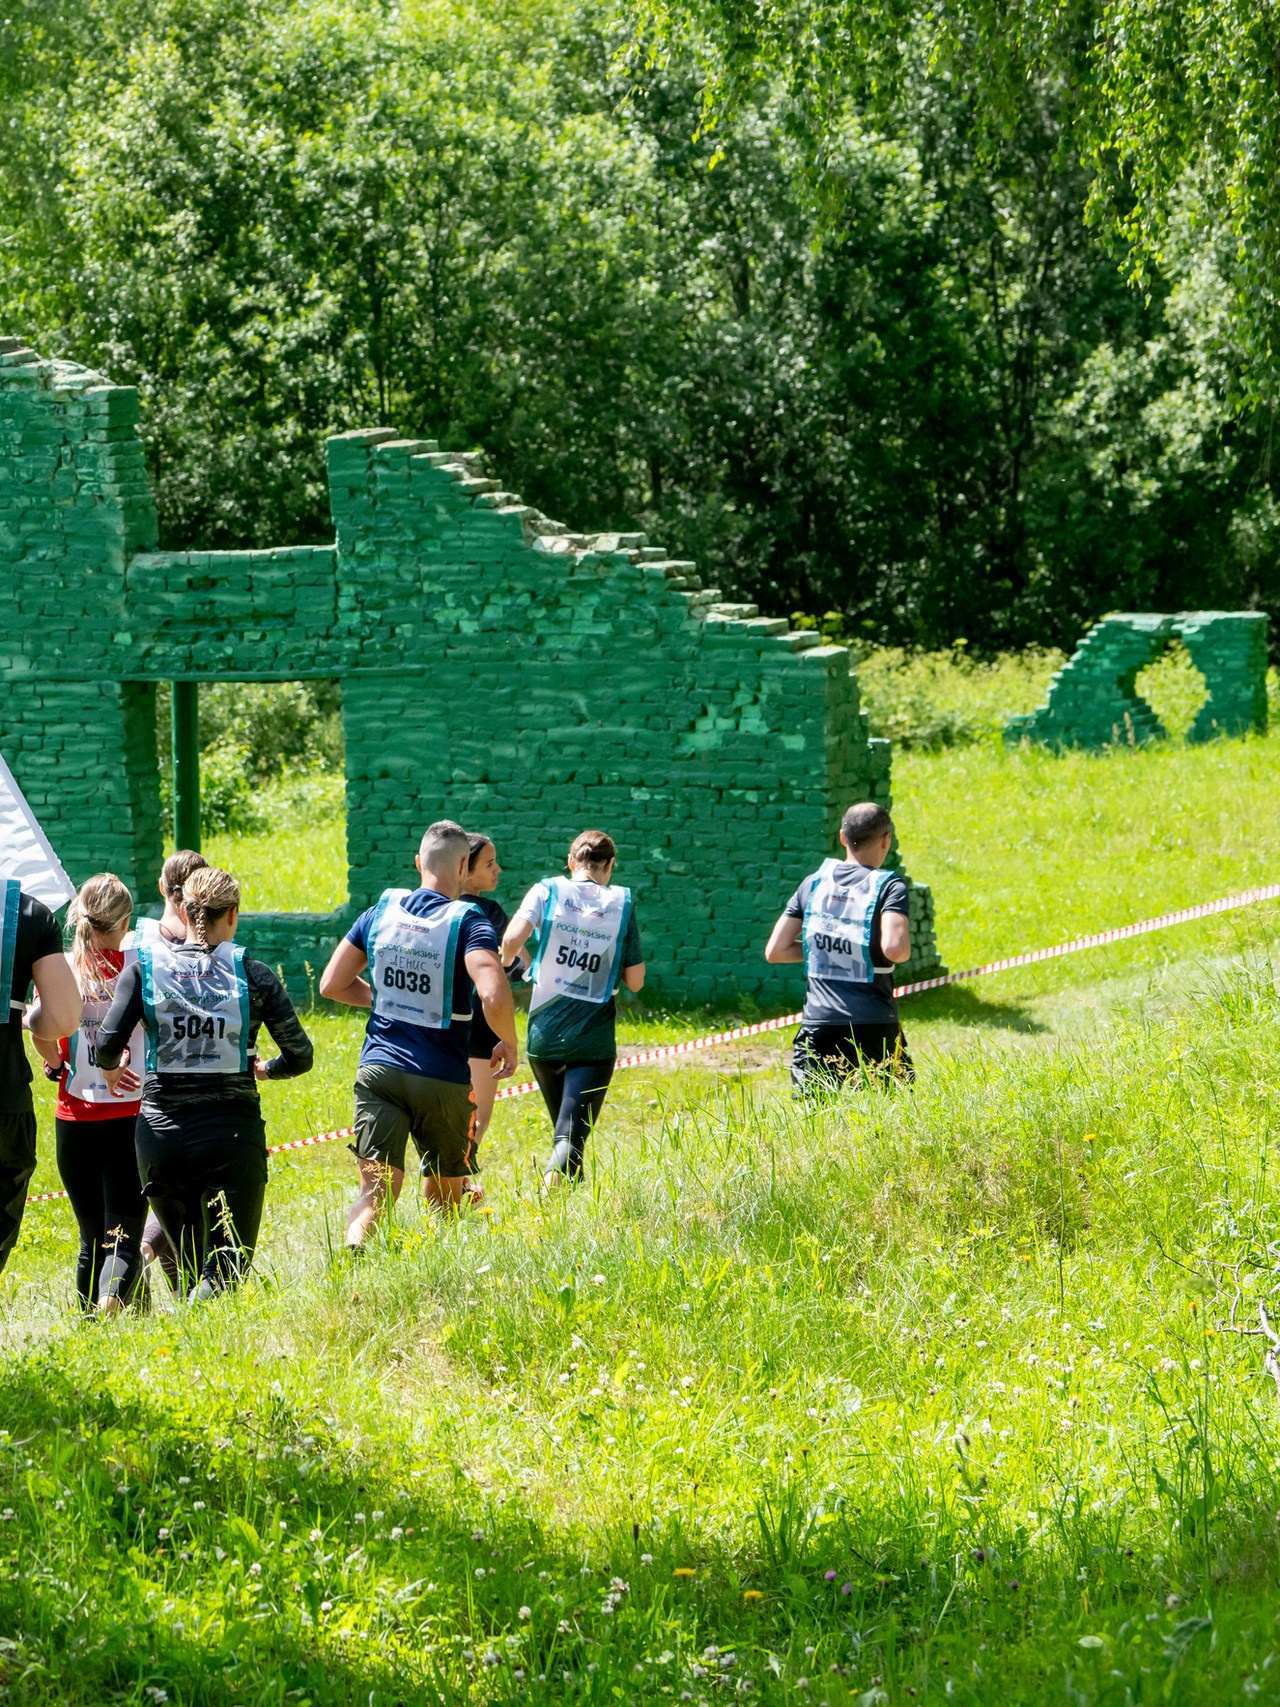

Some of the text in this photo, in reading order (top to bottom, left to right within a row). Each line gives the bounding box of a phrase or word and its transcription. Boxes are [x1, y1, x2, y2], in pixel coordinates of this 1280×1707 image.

[814, 932, 852, 955] 6040
[556, 945, 601, 973] 5040
[383, 966, 431, 995] 6038
[173, 1015, 226, 1040] 5041
